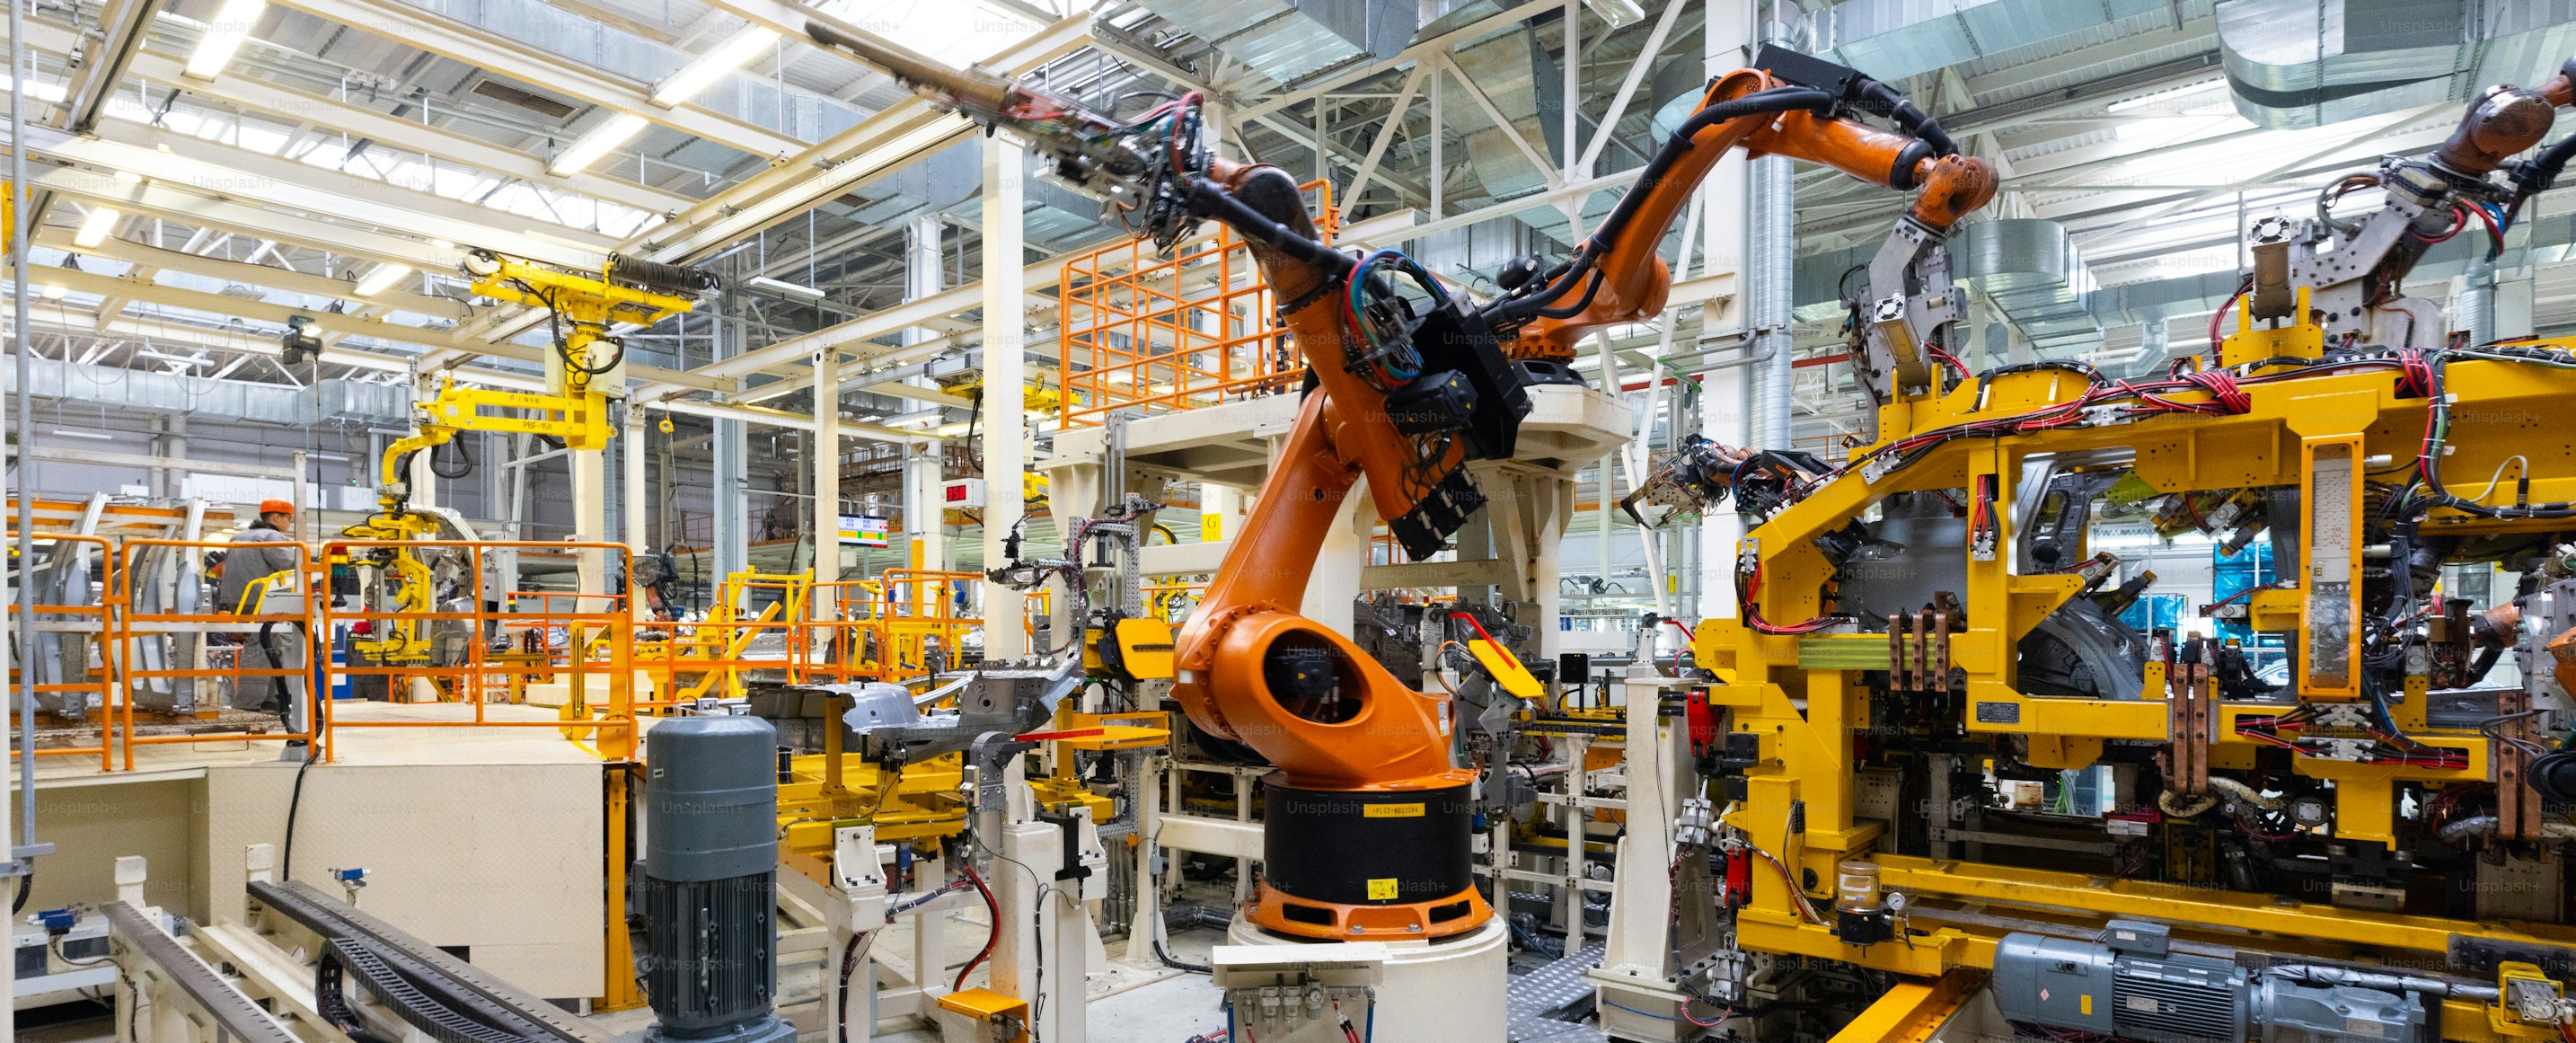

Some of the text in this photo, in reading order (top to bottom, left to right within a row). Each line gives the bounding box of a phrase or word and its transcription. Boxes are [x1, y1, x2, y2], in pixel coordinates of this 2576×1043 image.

[523, 421, 552, 430] PBF-150
[948, 486, 966, 500] 358
[1207, 515, 1216, 529] G
